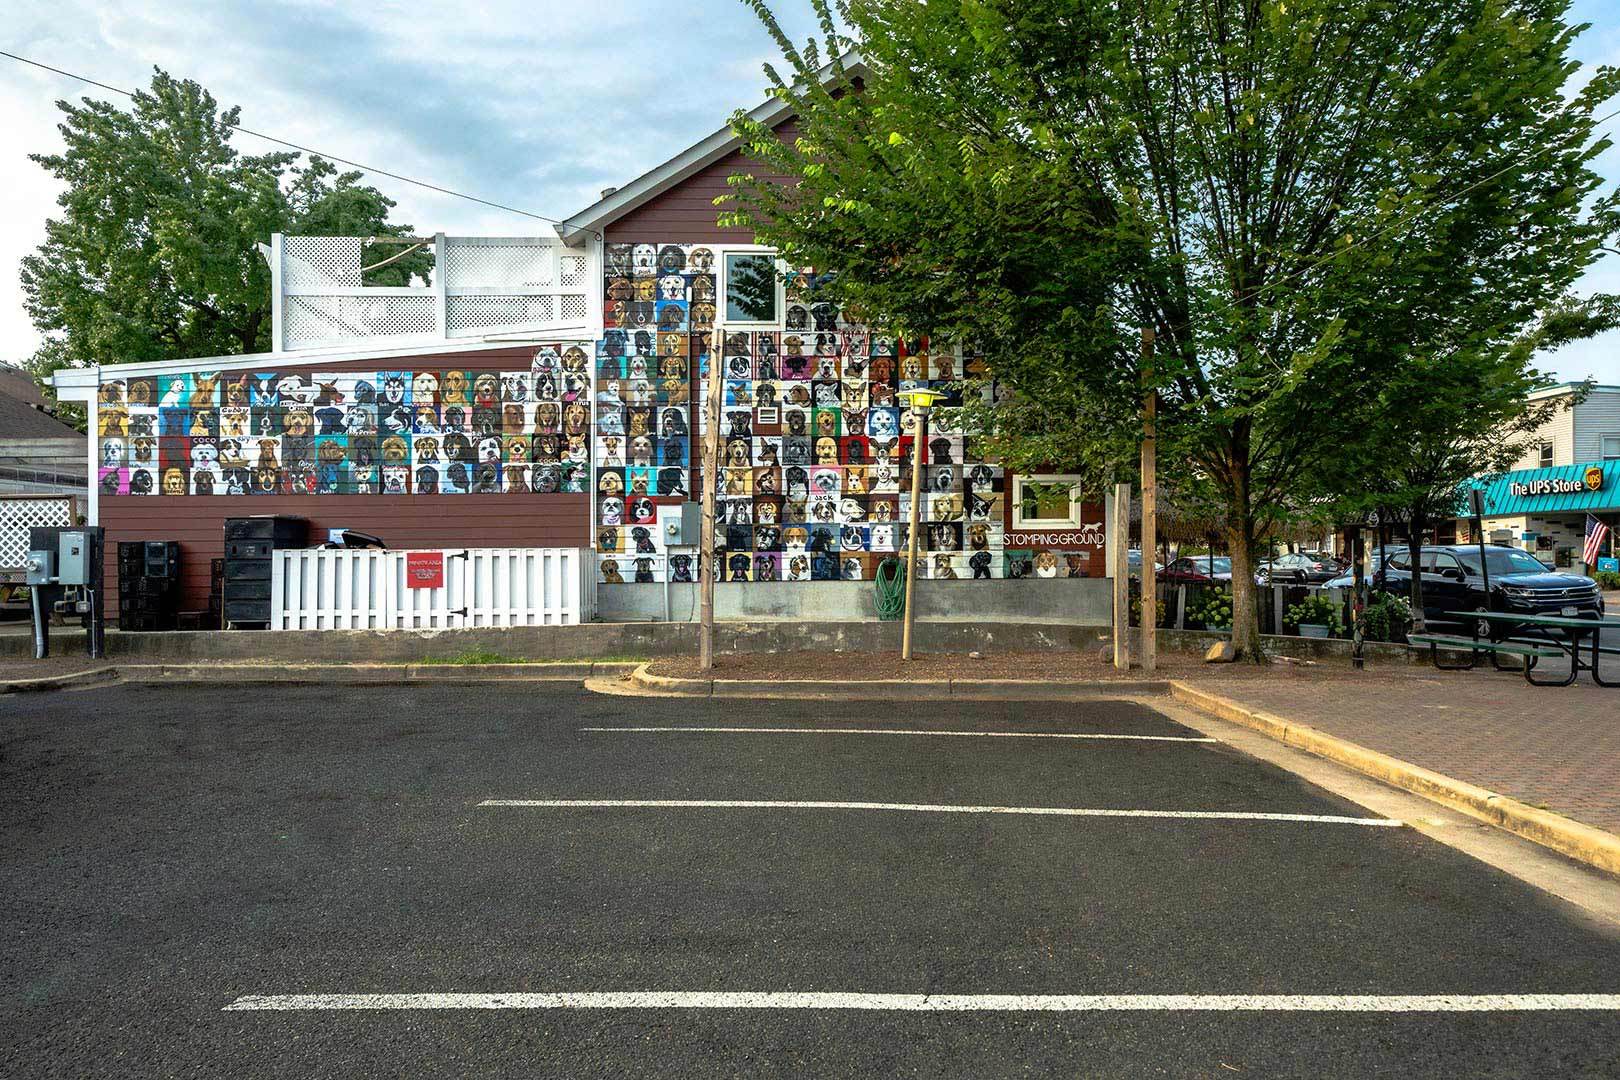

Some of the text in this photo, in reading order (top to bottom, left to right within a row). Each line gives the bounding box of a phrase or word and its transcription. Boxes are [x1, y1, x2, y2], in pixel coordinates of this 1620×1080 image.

[1510, 479, 1582, 496] The UPS Store
[1003, 533, 1105, 546] STOMPING GROUND
